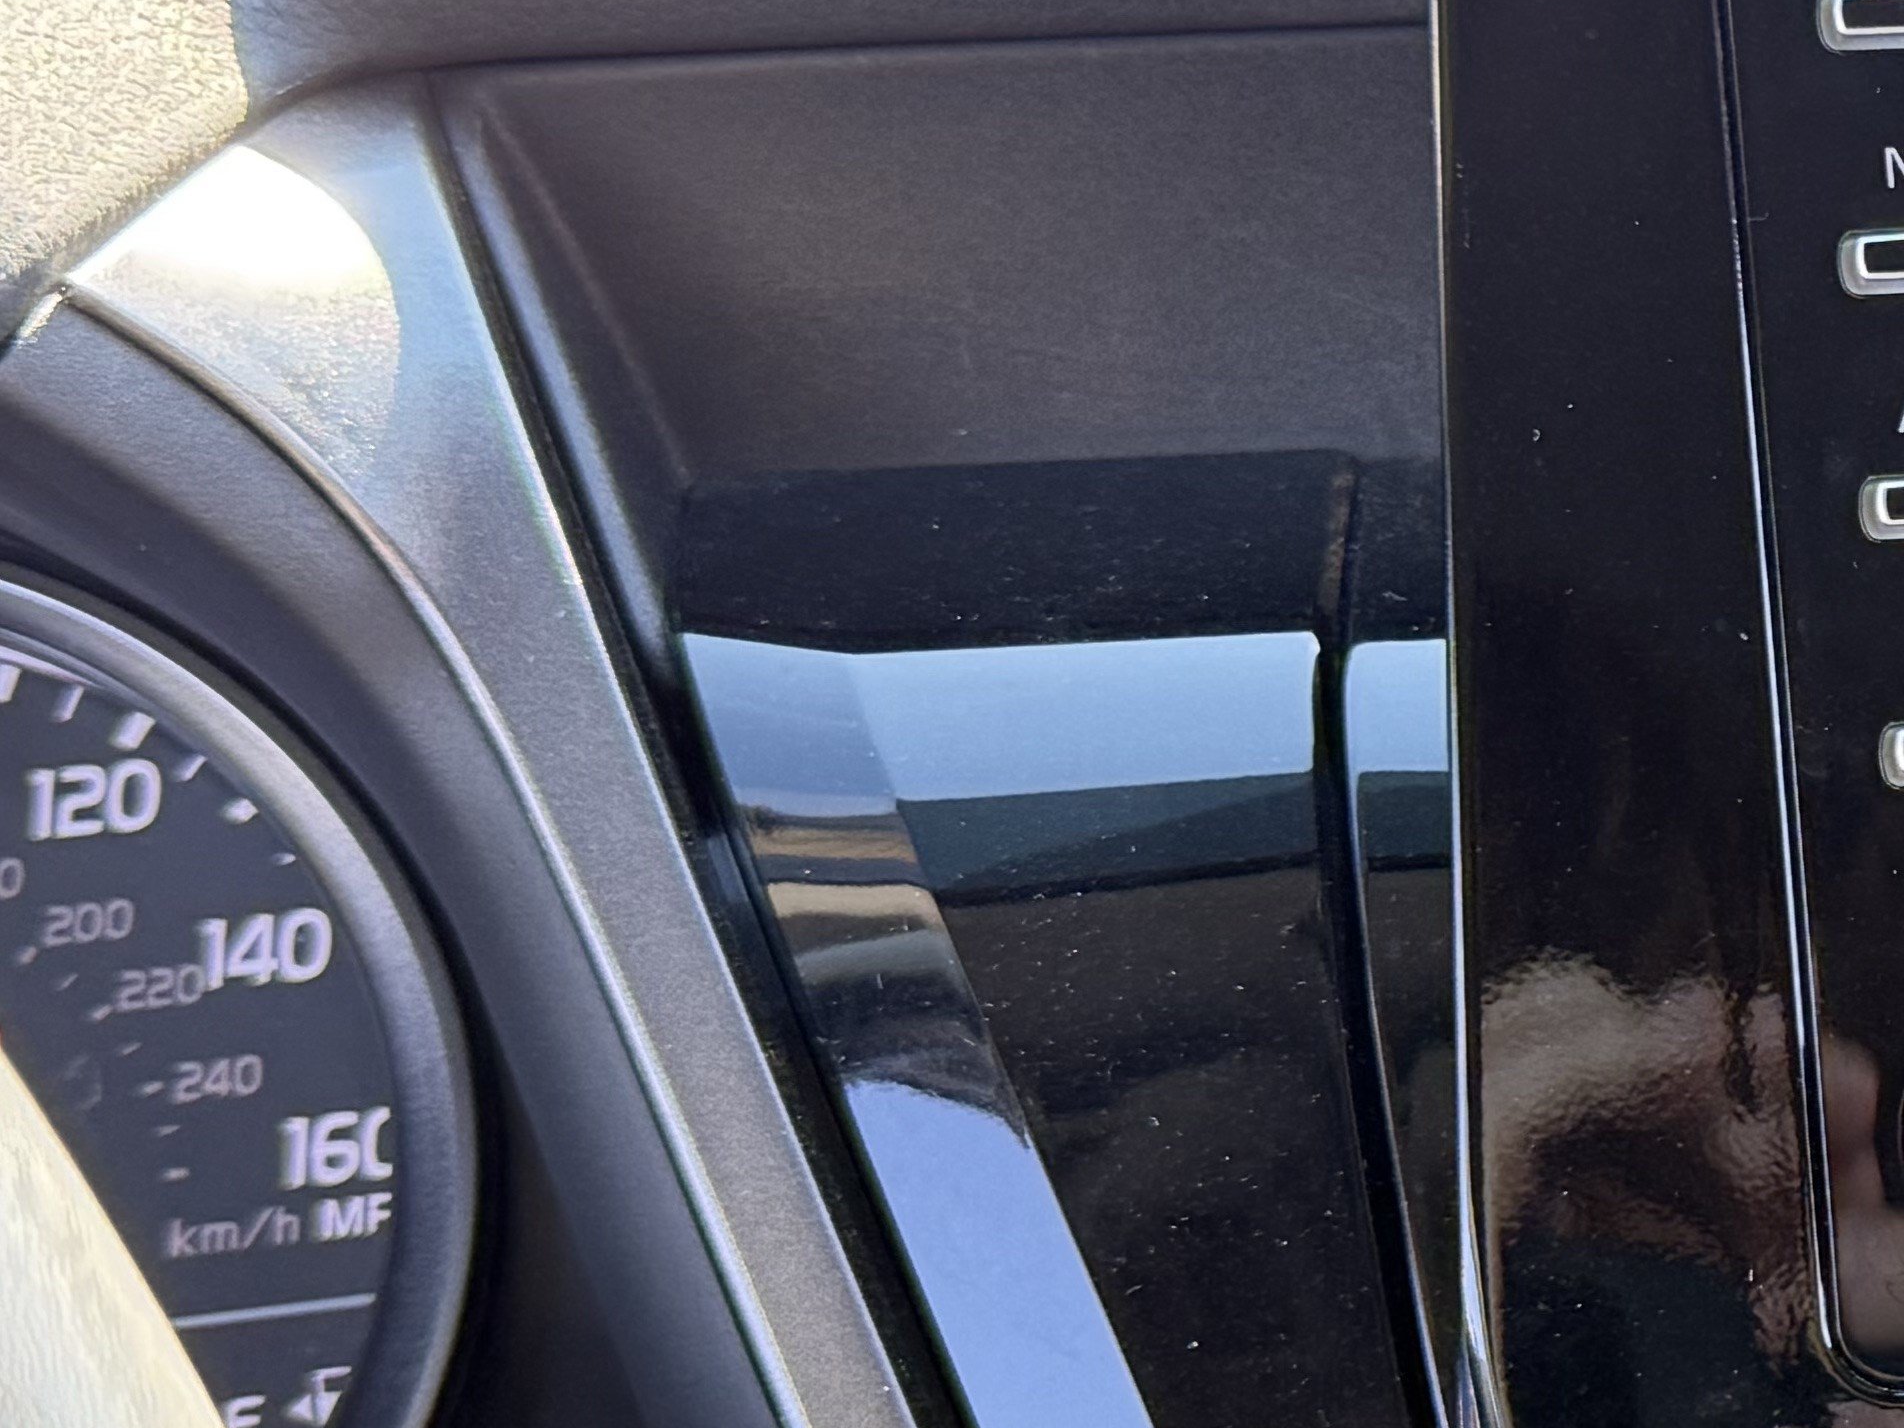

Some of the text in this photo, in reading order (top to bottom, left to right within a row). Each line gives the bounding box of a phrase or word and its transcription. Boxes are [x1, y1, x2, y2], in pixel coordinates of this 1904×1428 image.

[31, 759, 161, 839] 120
[42, 899, 133, 946] 200
[198, 907, 333, 992] 140
[116, 963, 202, 1013] 220
[172, 1055, 262, 1102] 240
[165, 1207, 299, 1257] km/h
